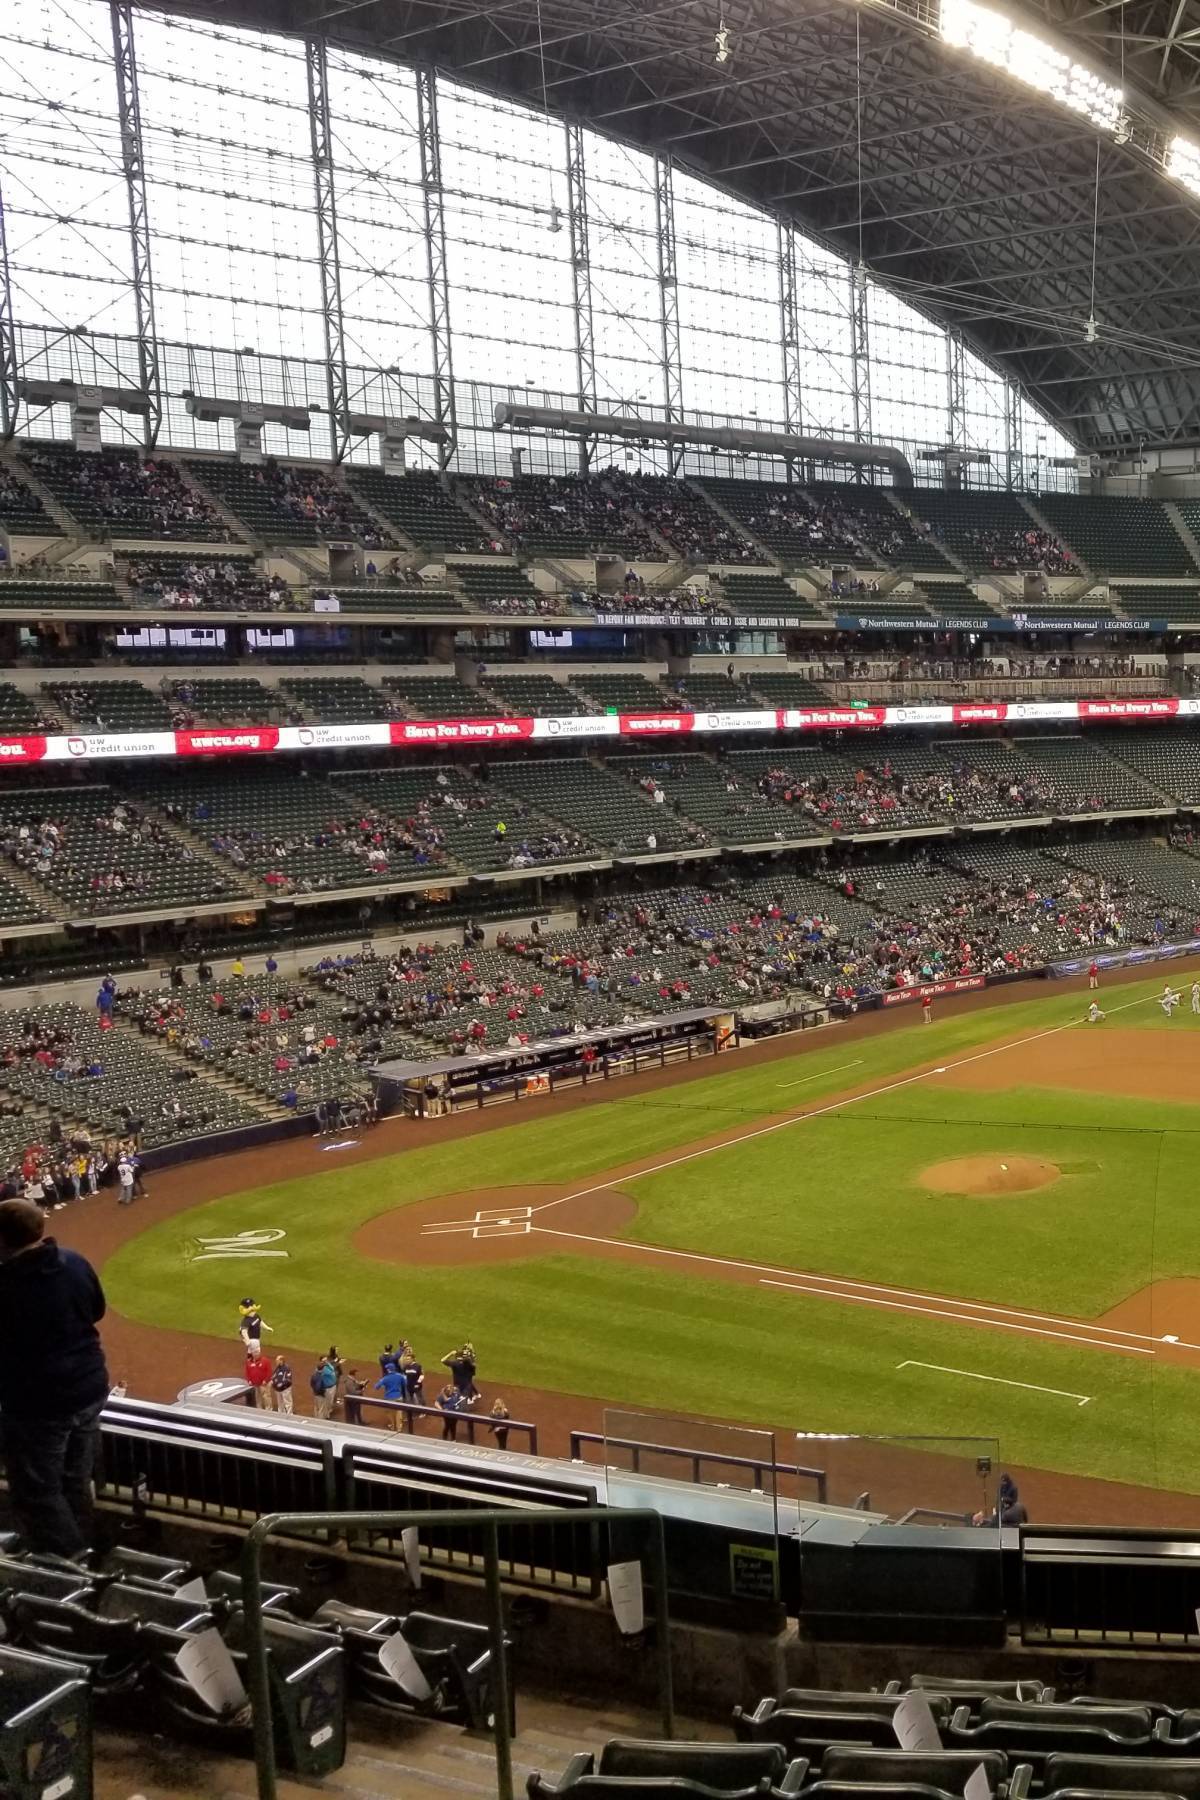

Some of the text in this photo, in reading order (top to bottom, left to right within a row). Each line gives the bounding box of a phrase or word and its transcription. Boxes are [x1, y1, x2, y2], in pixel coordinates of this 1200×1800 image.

[868, 619, 989, 629] Northwestern Mutual LEGENDS CLUB
[1024, 621, 1150, 630] Northwestern Mutual LEGENDS CLUB
[1088, 704, 1110, 714] Here
[1110, 704, 1126, 713] For
[1127, 703, 1151, 714] Every
[812, 710, 827, 722] For
[828, 710, 856, 722] Every
[405, 722, 521, 738] Here For Every You.
[190, 734, 260, 748] uwcu.org
[316, 734, 371, 744] credit union
[0, 743, 26, 756] ou.
[90, 743, 156, 753] credit union
[452, 1447, 553, 1470] HOME OF THE
